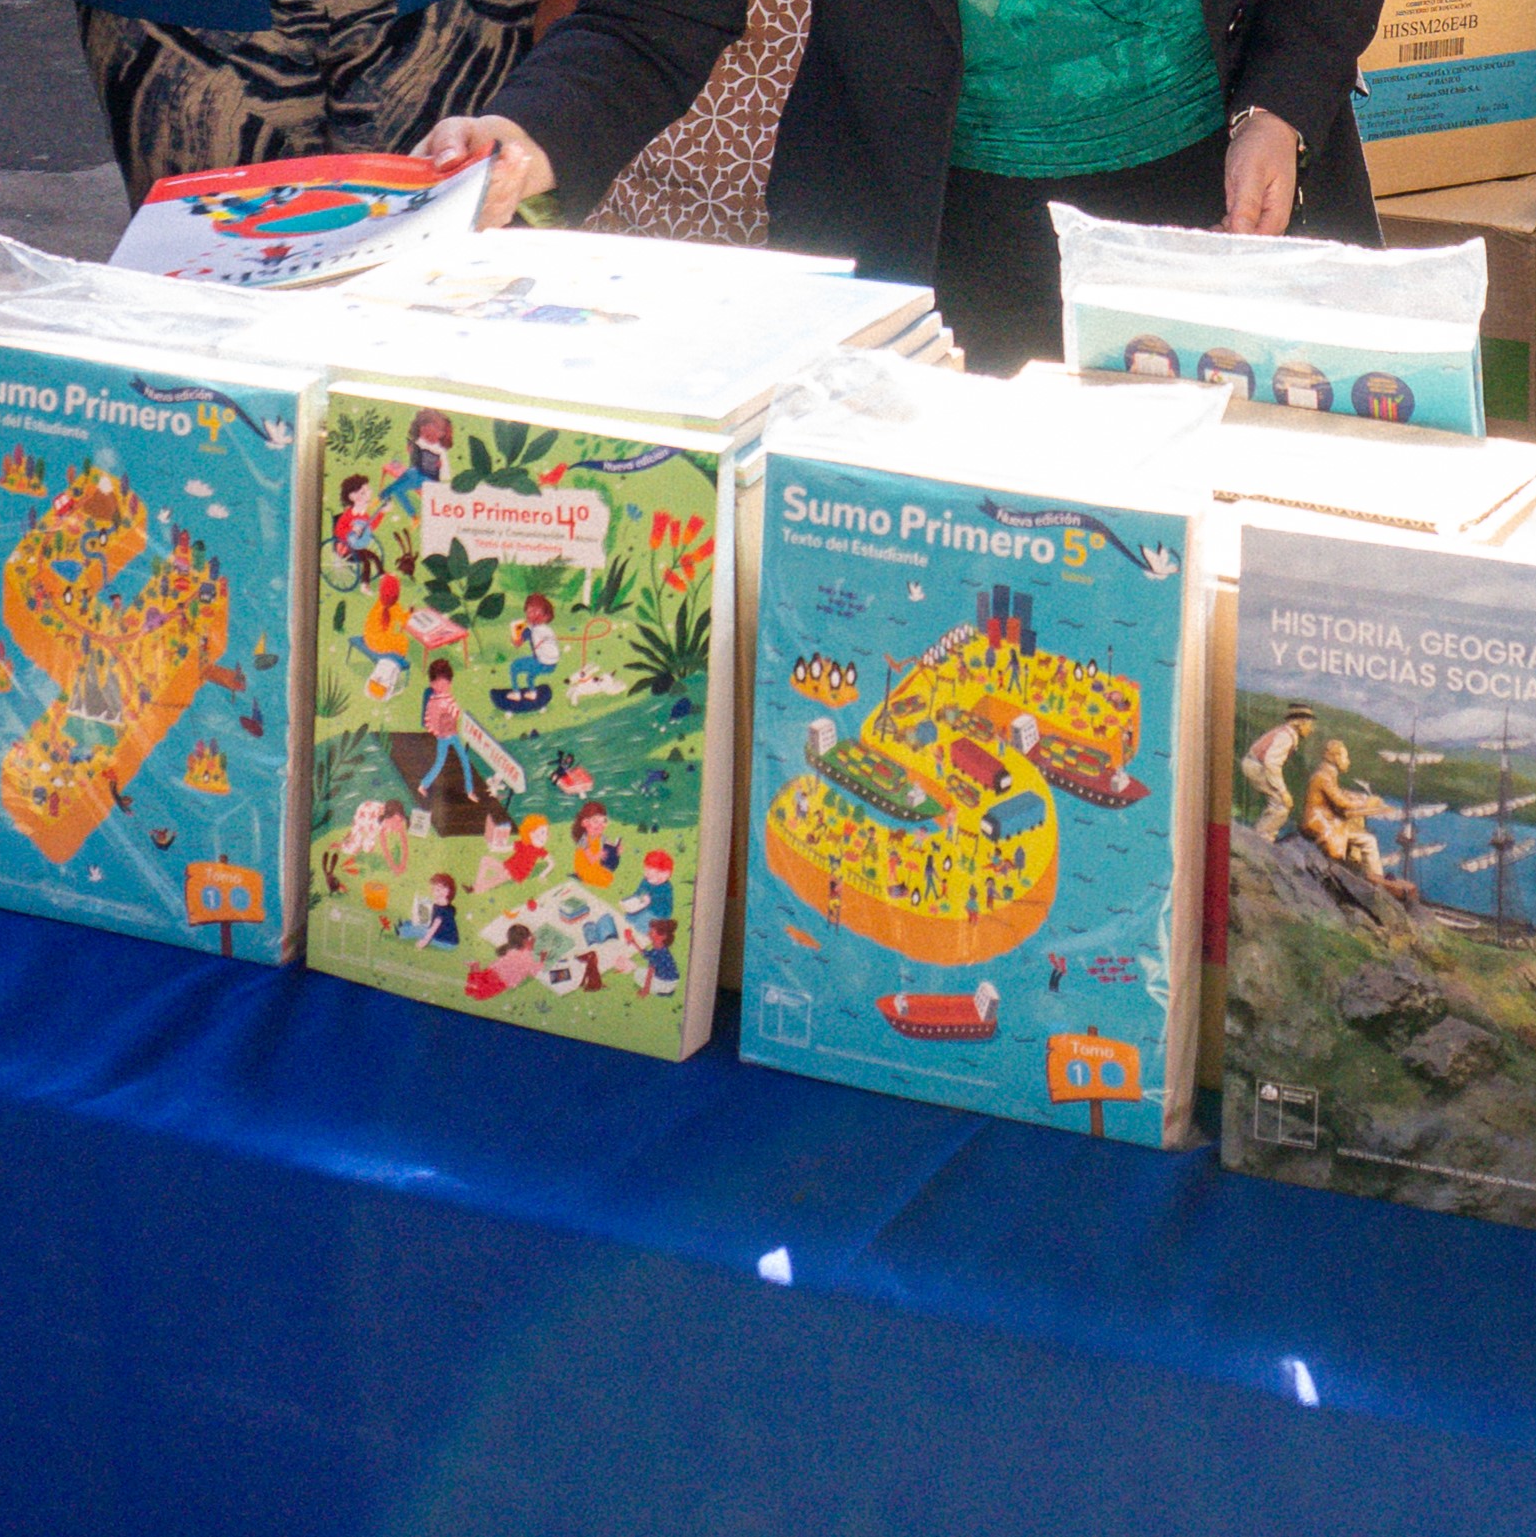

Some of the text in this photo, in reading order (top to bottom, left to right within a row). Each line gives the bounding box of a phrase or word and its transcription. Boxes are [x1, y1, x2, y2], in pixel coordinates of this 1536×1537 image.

[1383, 14, 1479, 39] HISSM26E4B
[64, 384, 192, 437] Primero
[431, 499, 464, 520] Leo
[472, 501, 553, 526] Primero
[782, 485, 891, 536] Sumo
[899, 504, 1056, 565] Primero
[996, 508, 1081, 528] Nueva edición
[782, 527, 929, 568] Texto del Estudiante
[1272, 608, 1411, 653] HISTORIA,
[1271, 640, 1290, 665] Y
[1297, 646, 1437, 689] CIENCIAS
[1071, 1041, 1115, 1059] Tomo
[1073, 1064, 1083, 1086] 1
